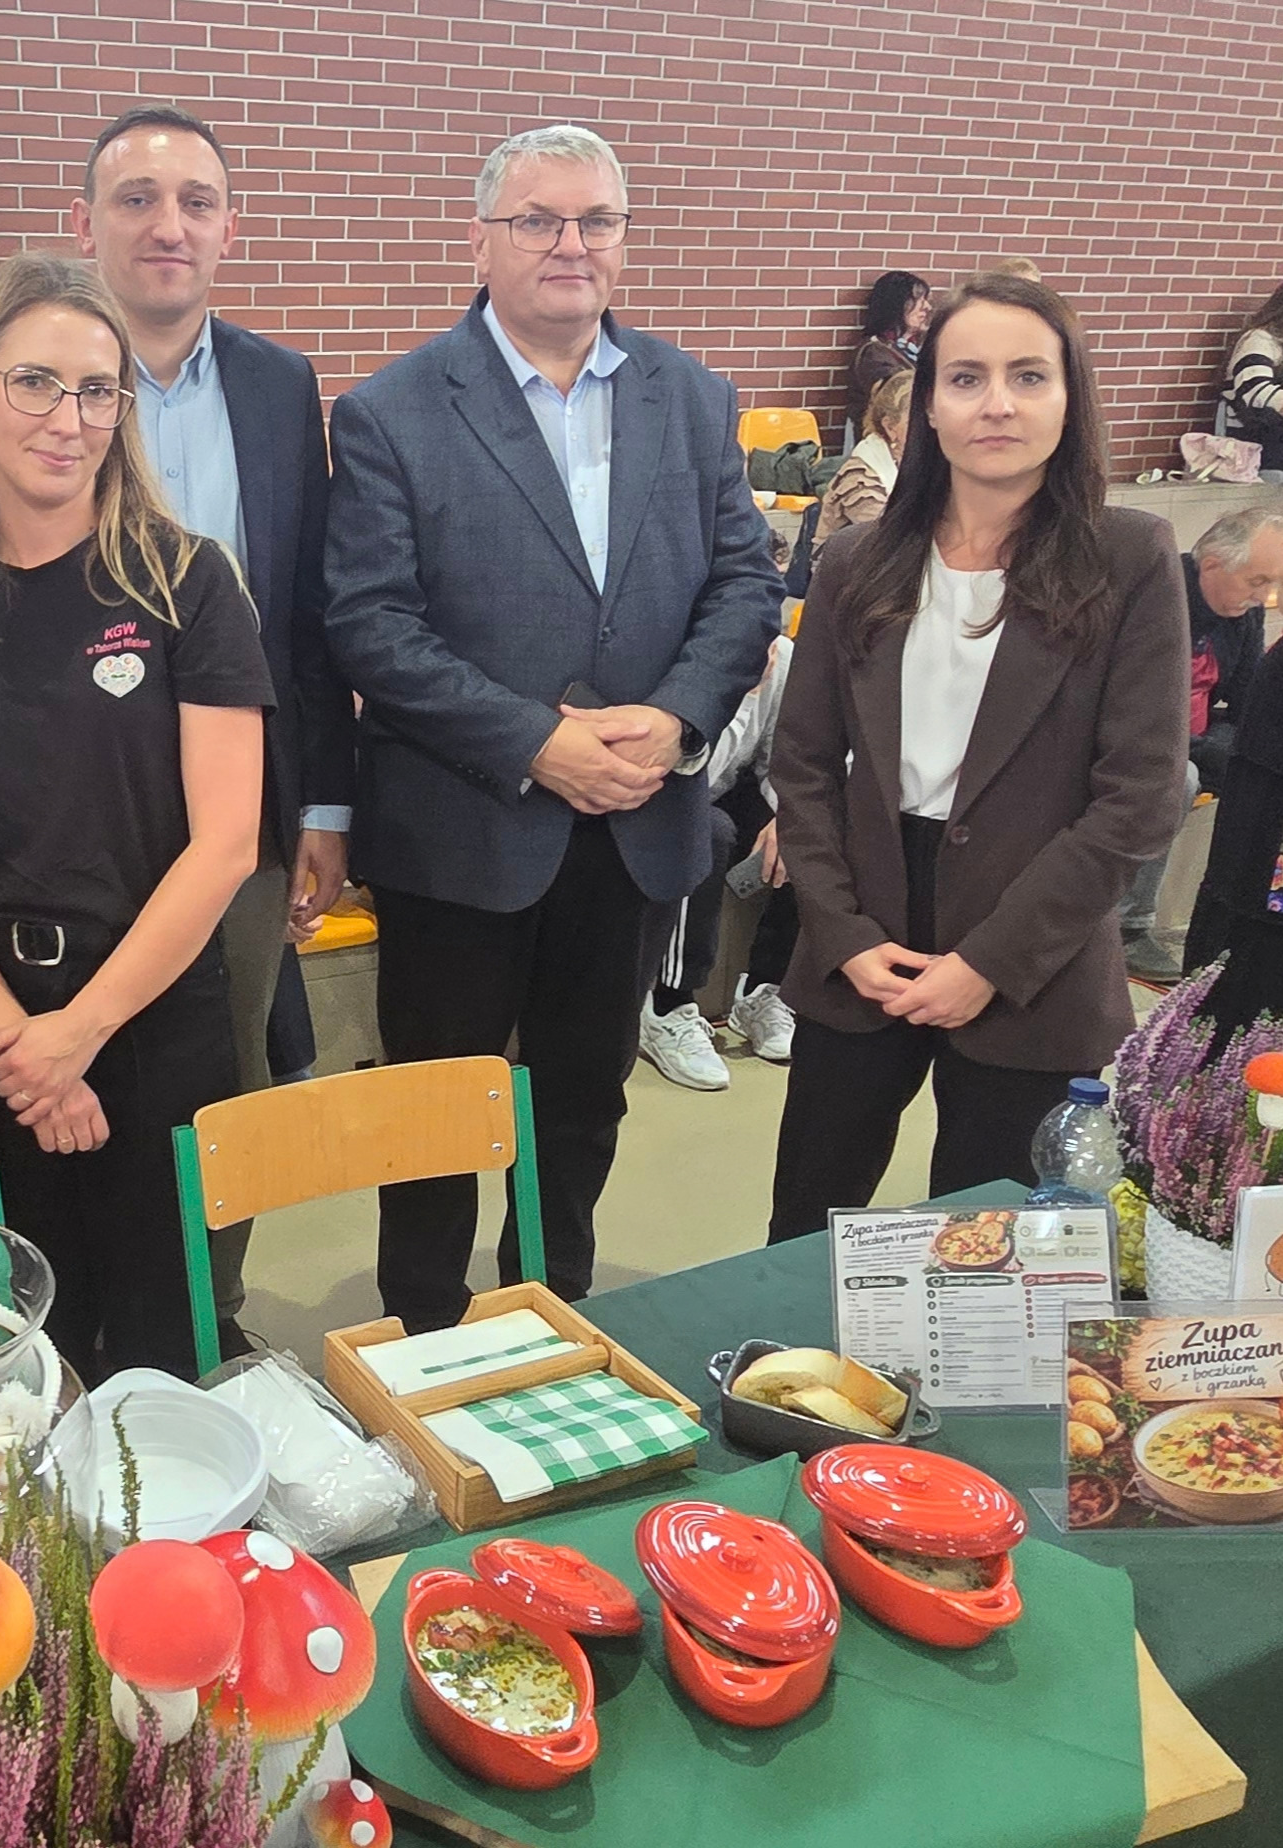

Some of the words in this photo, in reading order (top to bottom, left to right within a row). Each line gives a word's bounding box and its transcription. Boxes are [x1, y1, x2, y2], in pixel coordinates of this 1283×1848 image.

[104, 621, 137, 641] KGW
[841, 1223, 873, 1240] Zupa
[1181, 1321, 1263, 1350] Zupa
[1181, 1373, 1188, 1382] z
[1193, 1362, 1258, 1381] boczkiem
[1195, 1381, 1201, 1393] i
[1207, 1374, 1267, 1398] grzanką
